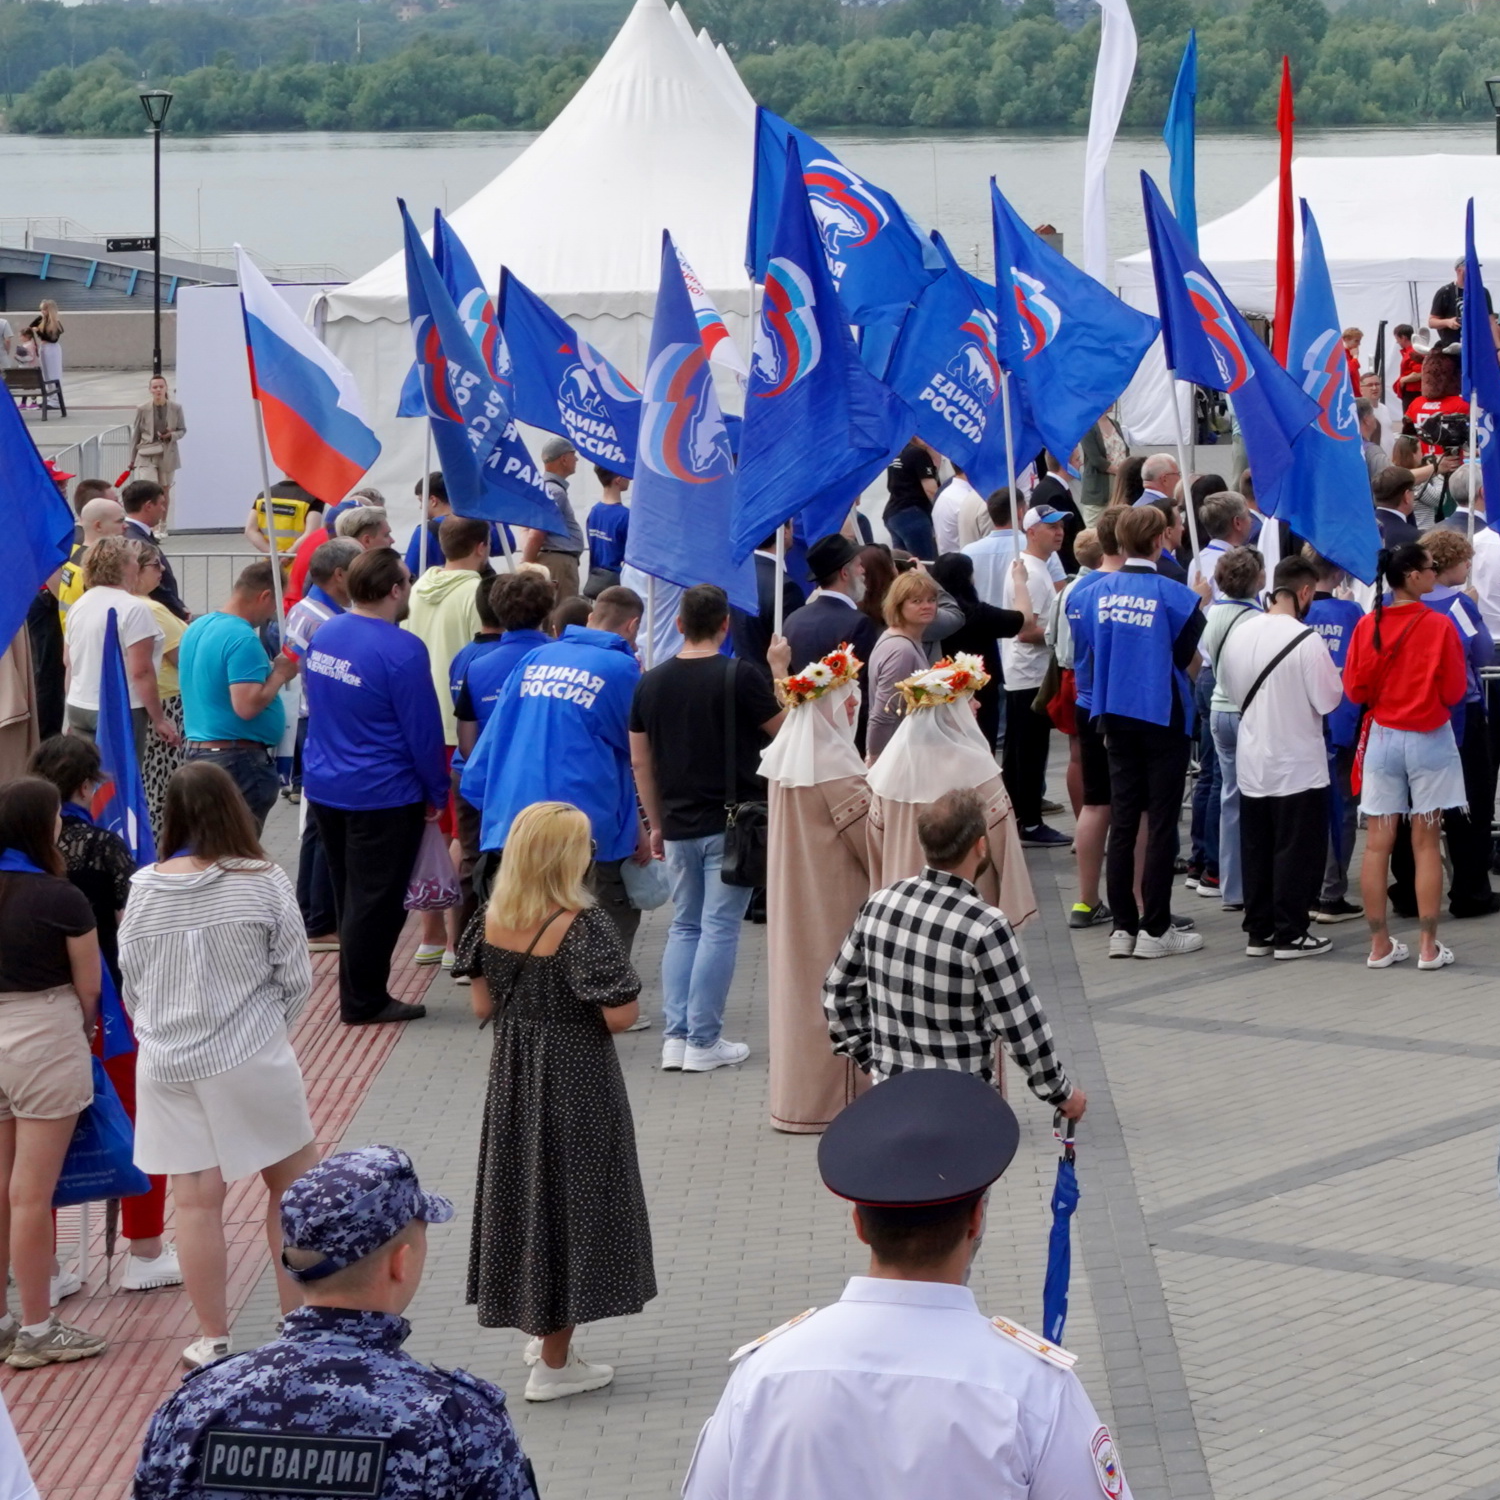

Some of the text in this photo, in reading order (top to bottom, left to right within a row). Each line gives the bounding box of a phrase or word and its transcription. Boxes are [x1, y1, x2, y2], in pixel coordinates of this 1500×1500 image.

[523, 664, 605, 693] ЕДИНАЯ
[520, 680, 597, 709] РОССИЯ
[211, 1443, 373, 1485] РОСГВАРДИЯ
